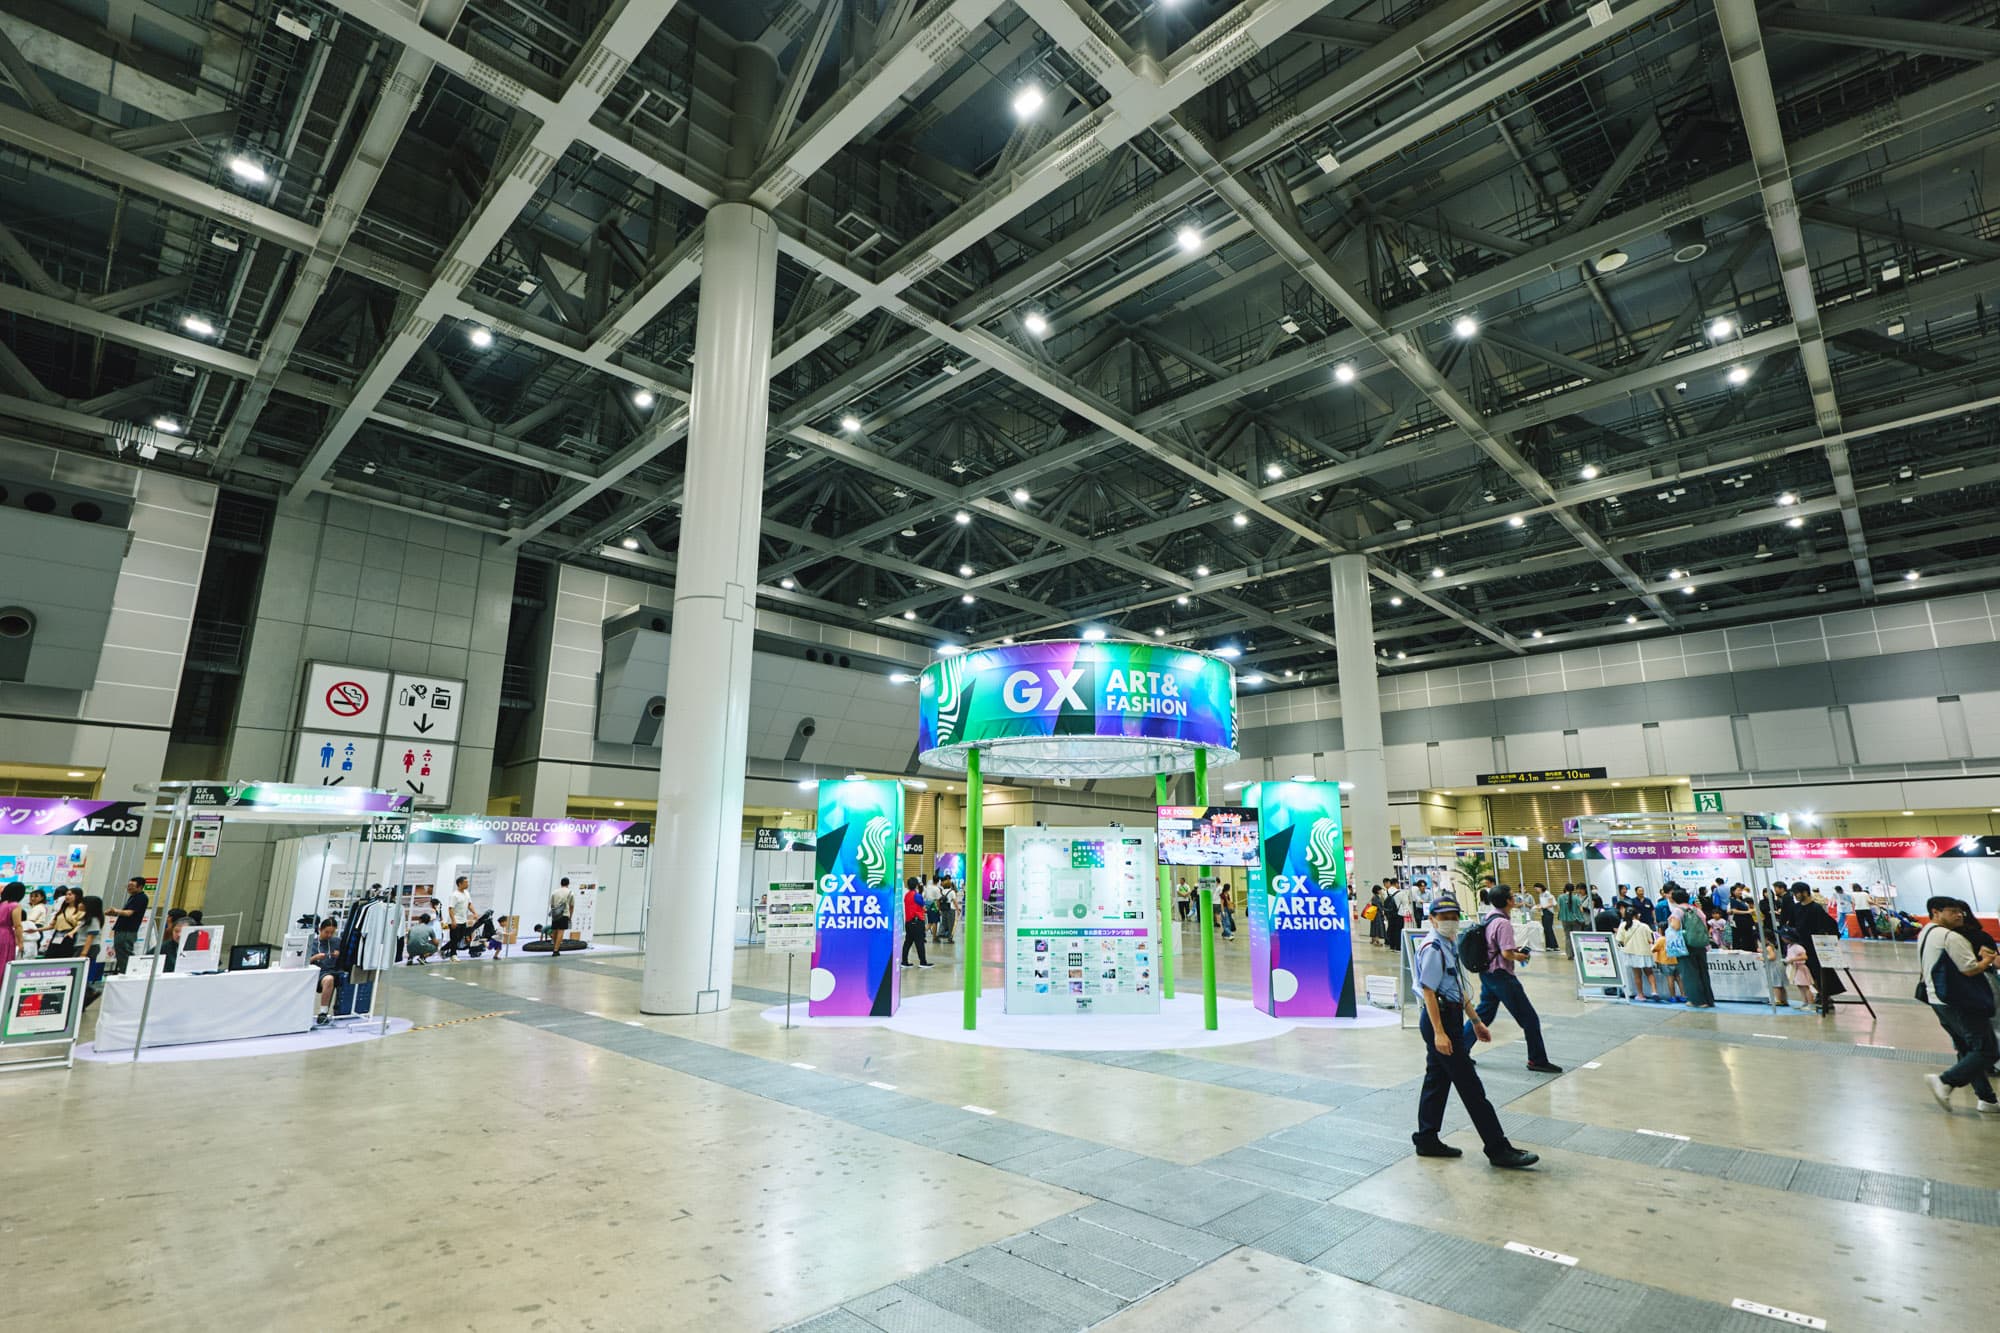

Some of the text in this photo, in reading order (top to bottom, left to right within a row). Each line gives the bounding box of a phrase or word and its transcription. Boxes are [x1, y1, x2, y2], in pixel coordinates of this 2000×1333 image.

[1003, 669, 1088, 713] GX
[1106, 669, 1180, 697] ART&
[1106, 695, 1187, 717] FASHION
[1519, 773, 1539, 781] 4.1m
[73, 818, 138, 832] AF-03
[512, 820, 541, 833] DEAL
[543, 821, 596, 833] COMPANY
[505, 833, 536, 843] KROC
[615, 835, 648, 845] AF-04
[820, 874, 856, 893] GX
[1272, 875, 1309, 894] GX
[819, 895, 882, 915] ART&
[1273, 896, 1337, 915] ART&
[818, 916, 889, 929] FASHION
[1274, 917, 1345, 930] FASHION
